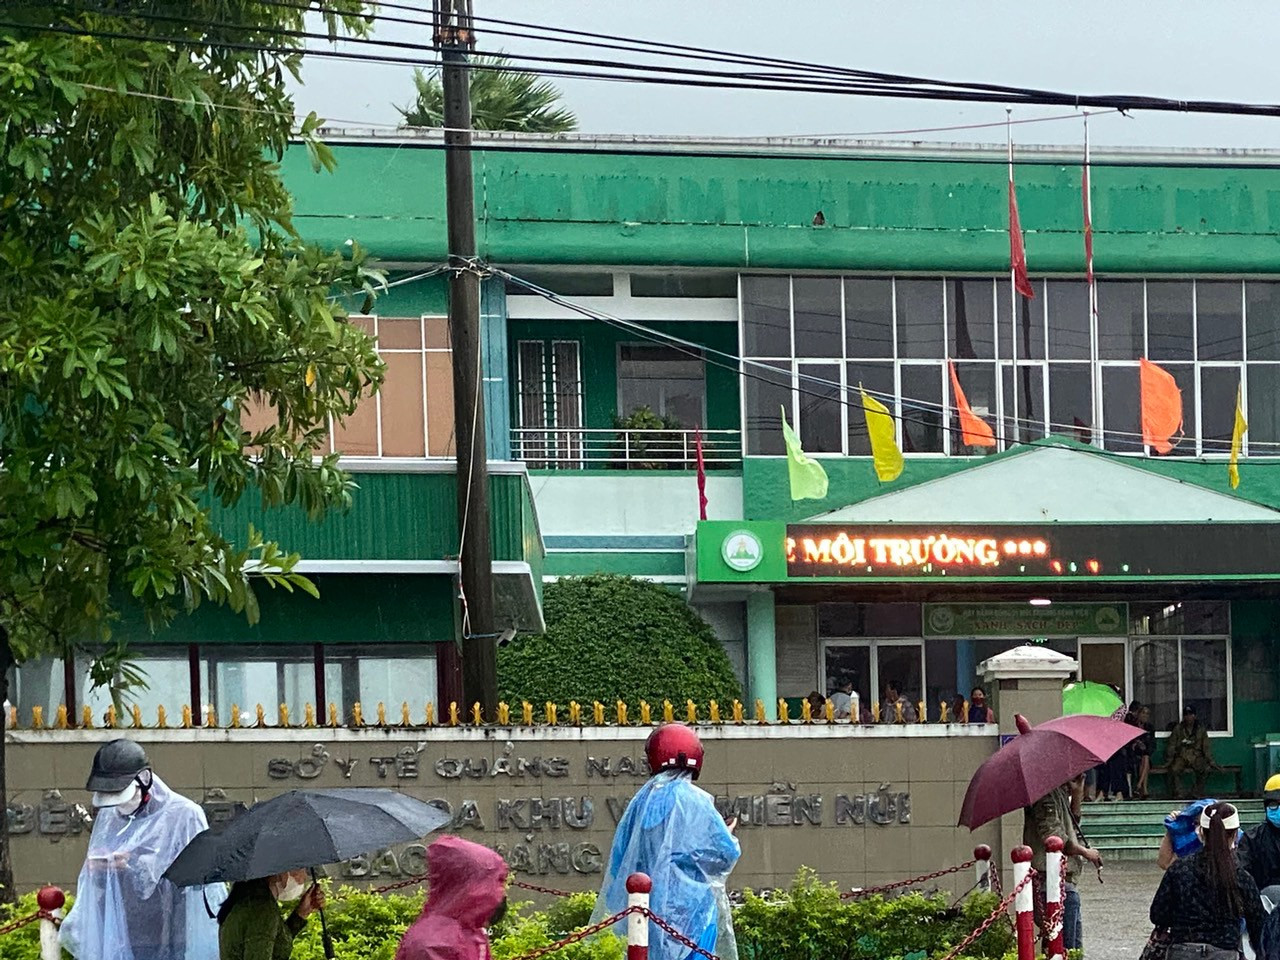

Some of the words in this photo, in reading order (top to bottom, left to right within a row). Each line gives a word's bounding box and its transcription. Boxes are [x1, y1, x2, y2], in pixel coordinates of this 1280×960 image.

[802, 532, 867, 566] MÔI
[869, 533, 999, 566] TRƯỜNG
[334, 757, 359, 779] Y
[369, 741, 427, 779] TẾ
[434, 741, 569, 779] QUẢNG
[498, 796, 595, 829] KHU
[834, 780, 911, 825] NÚI
